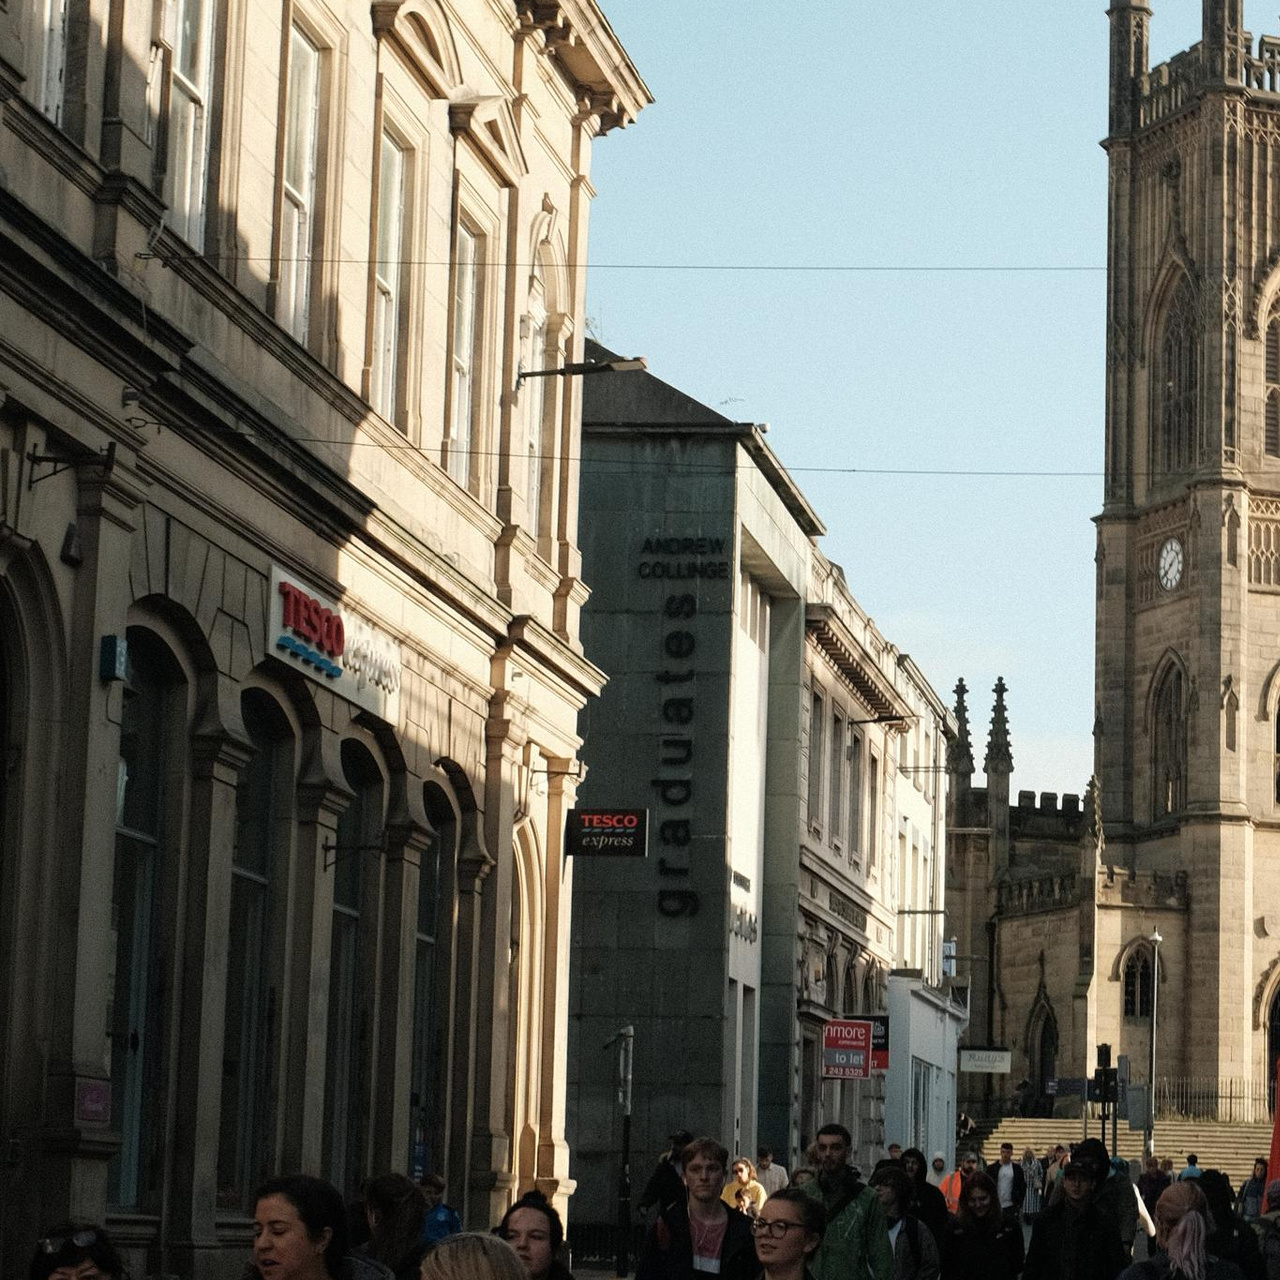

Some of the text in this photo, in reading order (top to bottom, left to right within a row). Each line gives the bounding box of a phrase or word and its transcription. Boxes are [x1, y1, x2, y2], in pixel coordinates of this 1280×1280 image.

[640, 537, 723, 556] ANDREW
[639, 561, 729, 579] COLLINGE
[278, 581, 346, 658] TESCO
[651, 593, 700, 919] graduates
[580, 815, 638, 828] TESCO
[581, 835, 634, 850] express
[835, 1053, 864, 1065] to let
